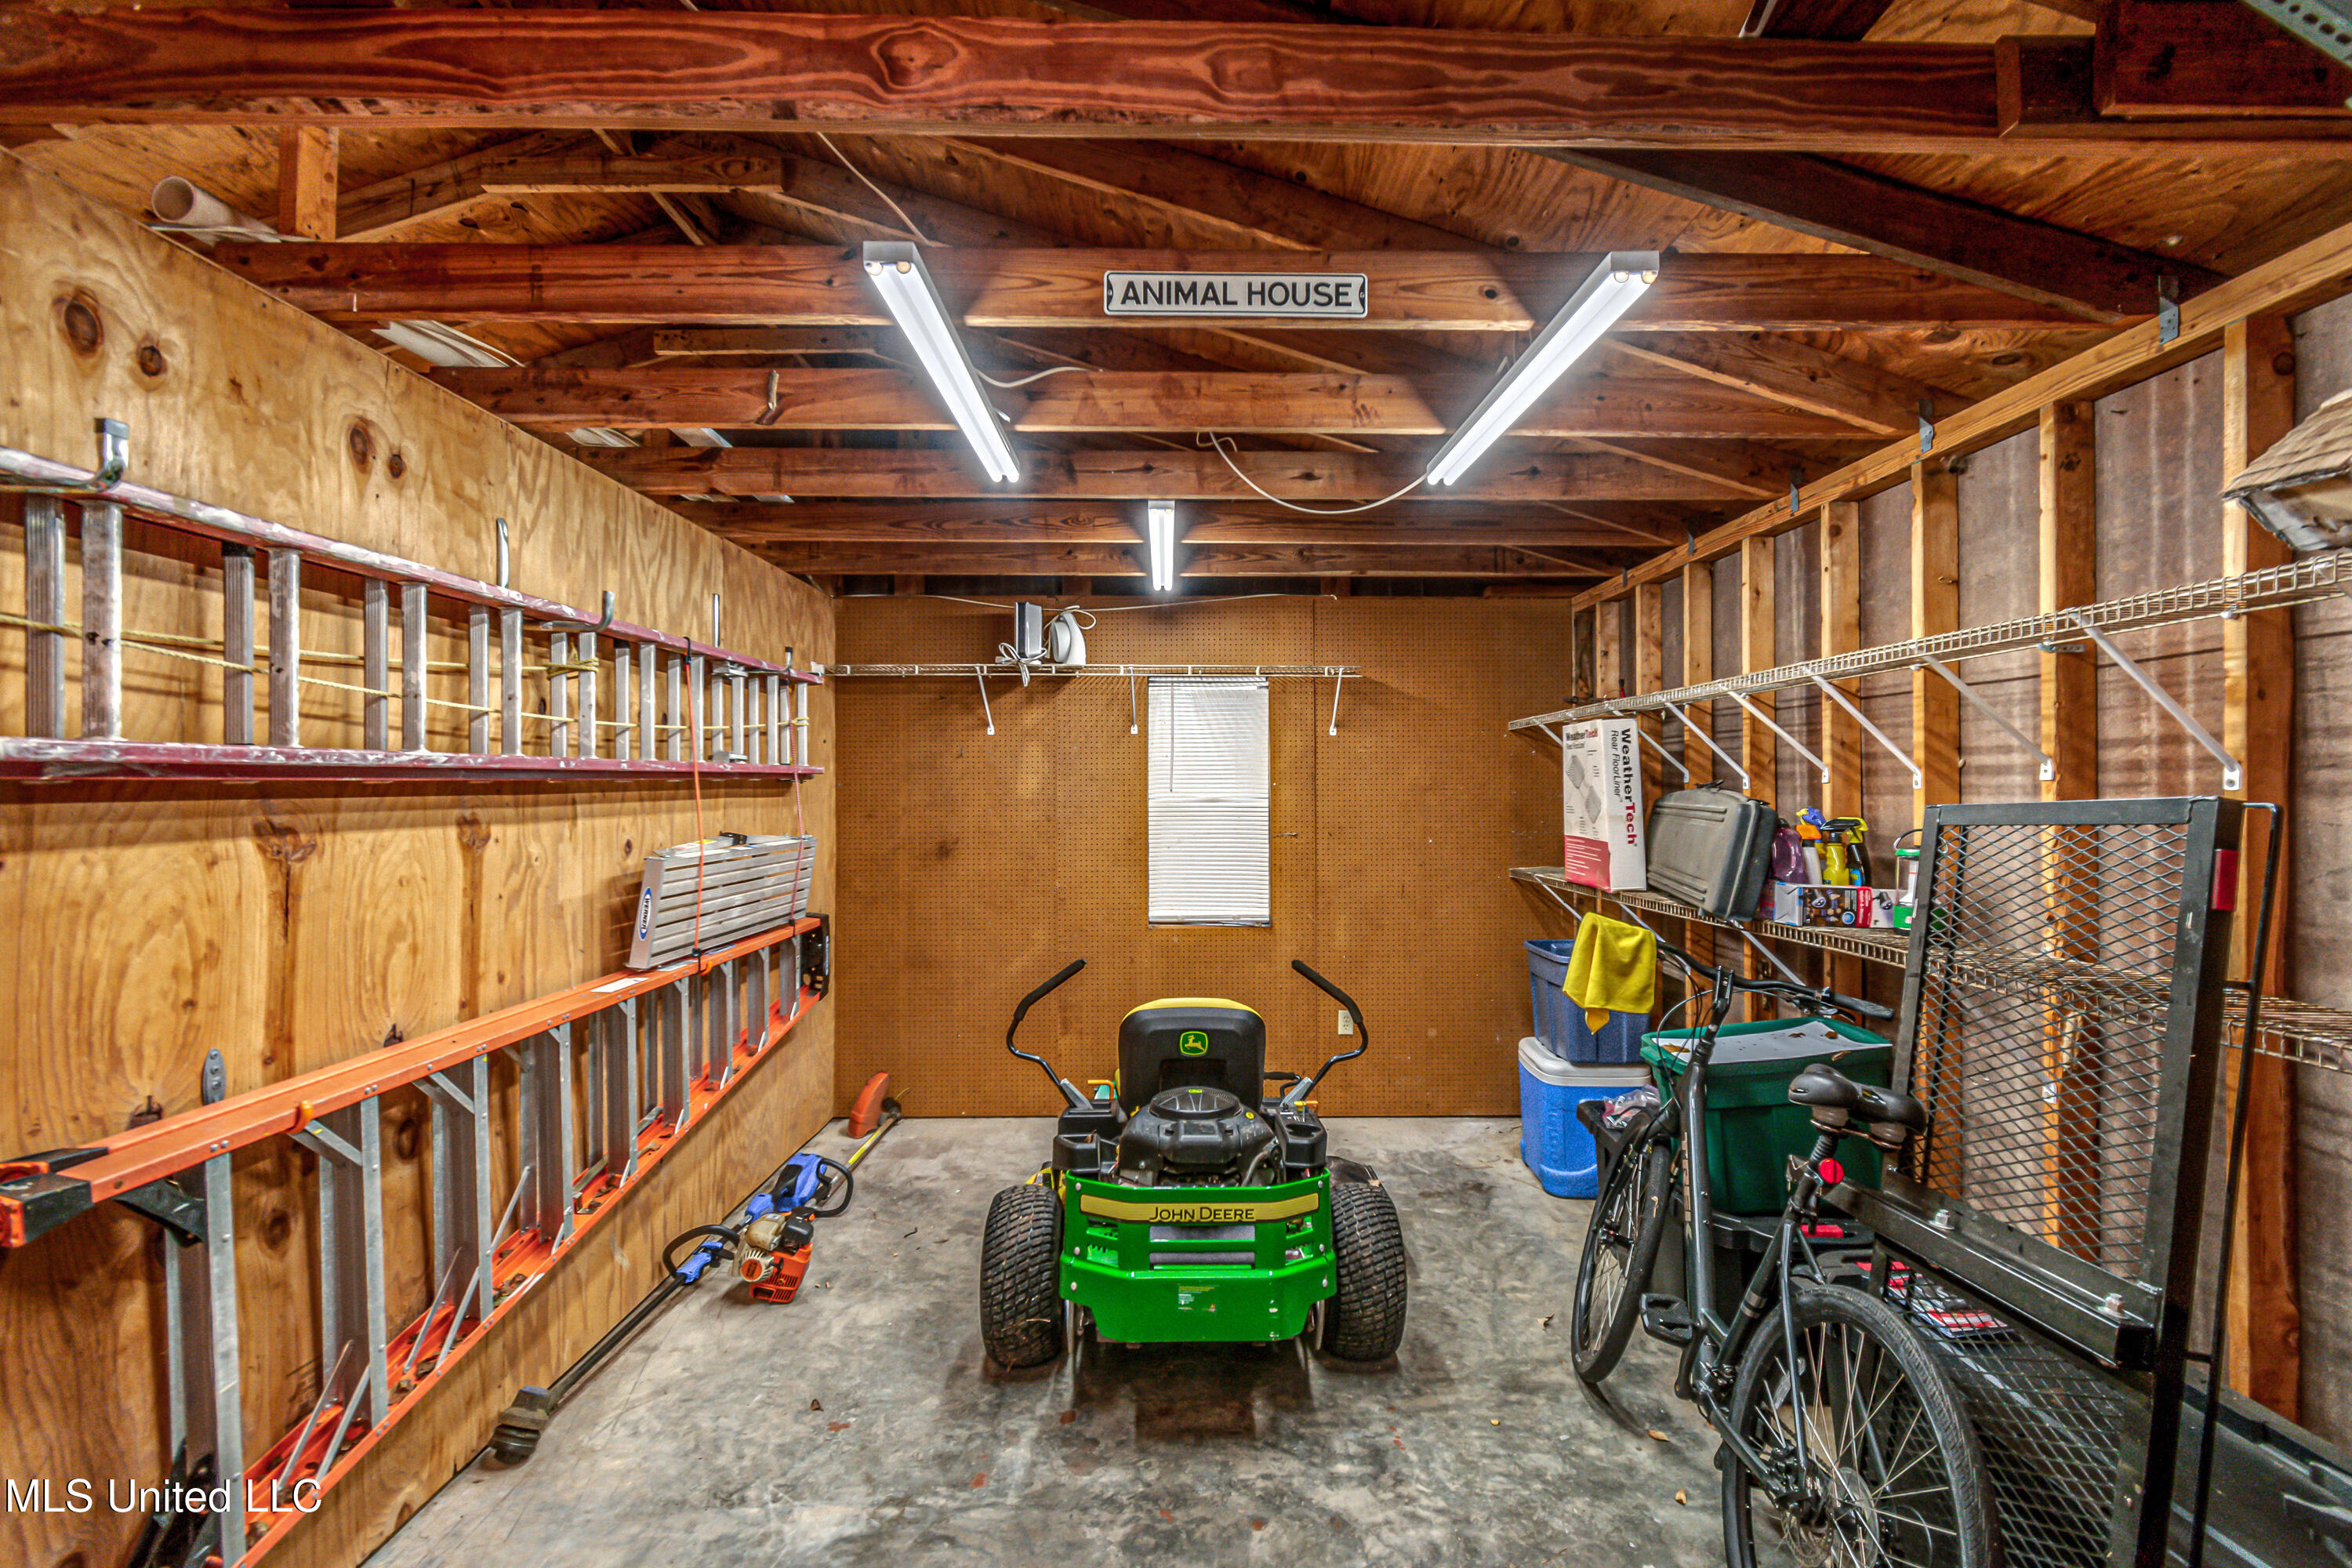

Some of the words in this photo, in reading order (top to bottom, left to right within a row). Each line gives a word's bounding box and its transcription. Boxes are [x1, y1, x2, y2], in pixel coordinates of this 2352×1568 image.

[1120, 280, 1238, 307] ANIMAL
[1248, 281, 1352, 307] HOUSE
[1611, 730, 1620, 751] Rear
[1621, 728, 1638, 844] WeatherTech
[1149, 1207, 1196, 1221] JOHN
[1200, 1207, 1255, 1221] DEERE
